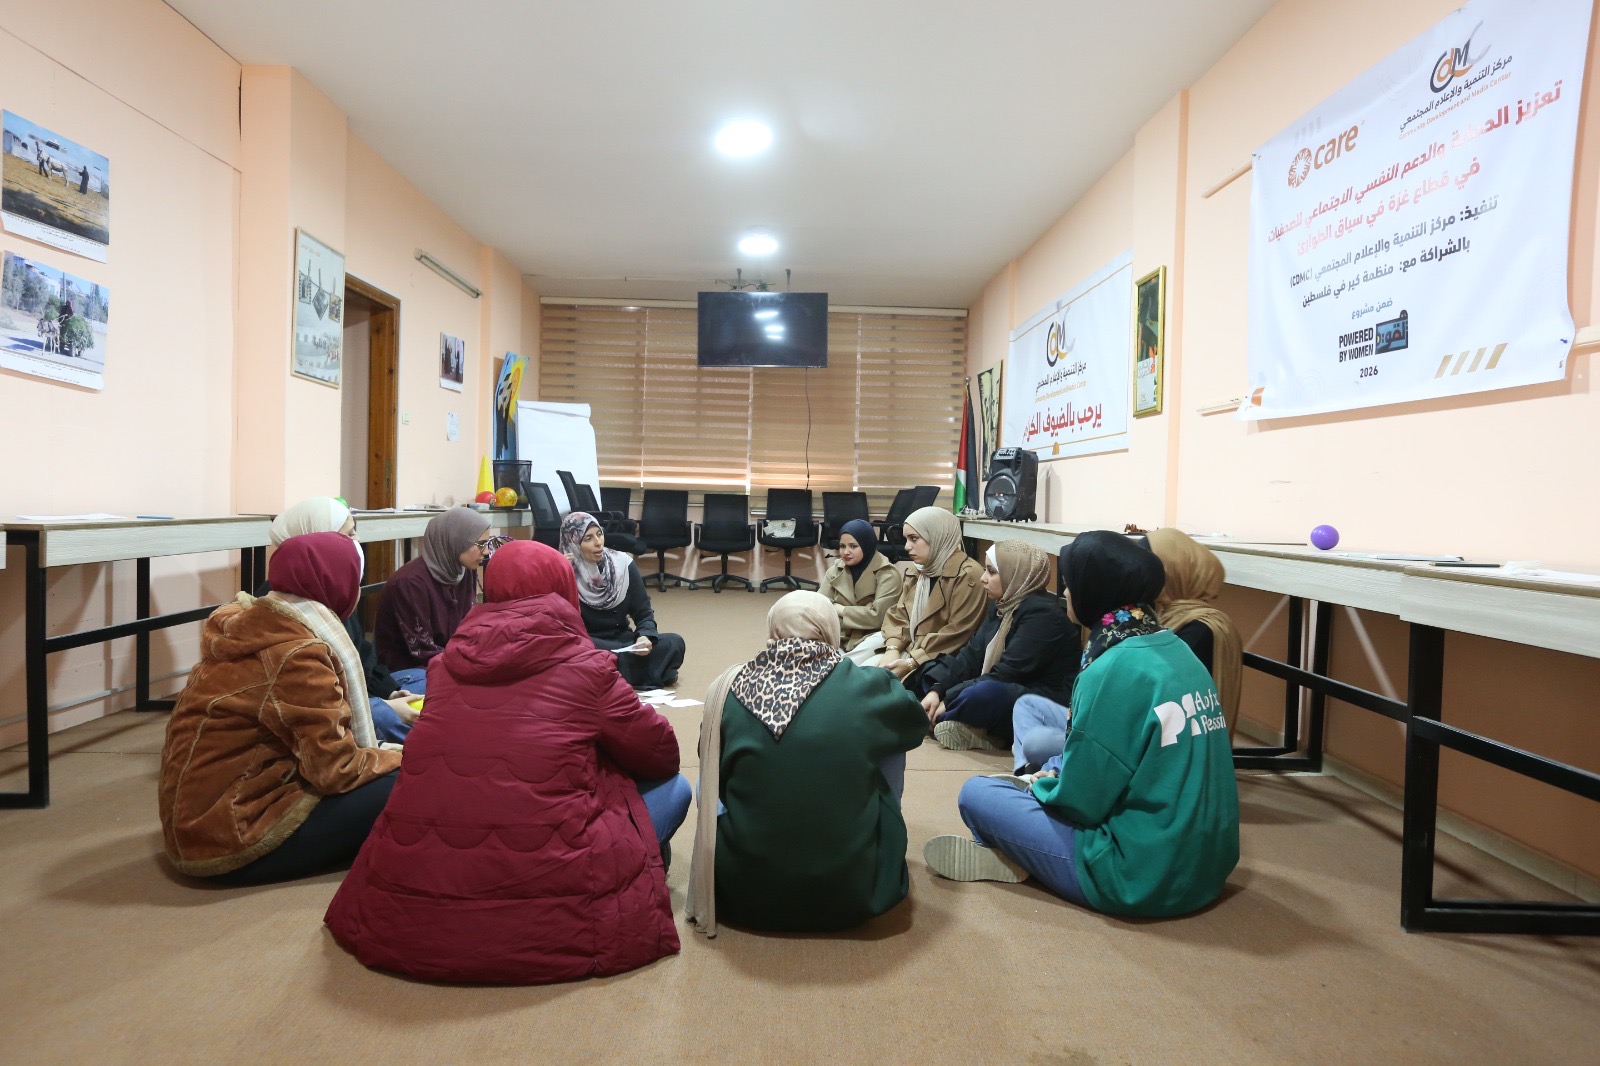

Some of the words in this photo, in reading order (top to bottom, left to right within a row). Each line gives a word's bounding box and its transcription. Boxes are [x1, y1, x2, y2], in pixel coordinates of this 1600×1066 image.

[1463, 65, 1490, 90] التنمية
[1490, 55, 1513, 76] مركز
[1426, 100, 1460, 125] Development
[1460, 94, 1471, 106] and
[1471, 83, 1489, 97] Media
[1489, 71, 1512, 87] Center
[1434, 85, 1462, 110] والإعلام
[1515, 79, 1563, 126] تعزيز
[1399, 100, 1434, 132] المجتمعي
[1313, 125, 1359, 170] care
[1401, 142, 1445, 179] والدعم
[1355, 163, 1399, 204] النفسي
[1454, 157, 1480, 190] في
[1413, 170, 1450, 204] قطاع
[1305, 186, 1353, 228] الاجتماعي
[1388, 188, 1410, 212] غزة
[1459, 194, 1499, 221] تنفيذ:
[1335, 214, 1363, 239] سياق
[1366, 200, 1385, 228] في
[1430, 215, 1456, 236] مركز
[1268, 211, 1302, 243] للصحفيات
[1393, 221, 1427, 248] التنمية
[1354, 239, 1390, 264] والإعلام
[1419, 236, 1471, 262] بالشراكة
[1314, 252, 1352, 282] المجتمعي
[1362, 264, 1394, 283] منظمة
[1399, 257, 1417, 273] مع:
[1333, 279, 1346, 298] في
[1347, 274, 1360, 292] كير
[1302, 284, 1332, 308] فلسطين
[1376, 297, 1393, 313] ضمن
[1351, 302, 1375, 320] مشروع
[1338, 327, 1374, 348] POWERED
[1338, 349, 1348, 363] BY
[1348, 343, 1374, 361] WOMEN
[1359, 365, 1379, 378] 2026
[1042, 401, 1075, 437] بالضيوف
[1077, 403, 1102, 431] يرحب
